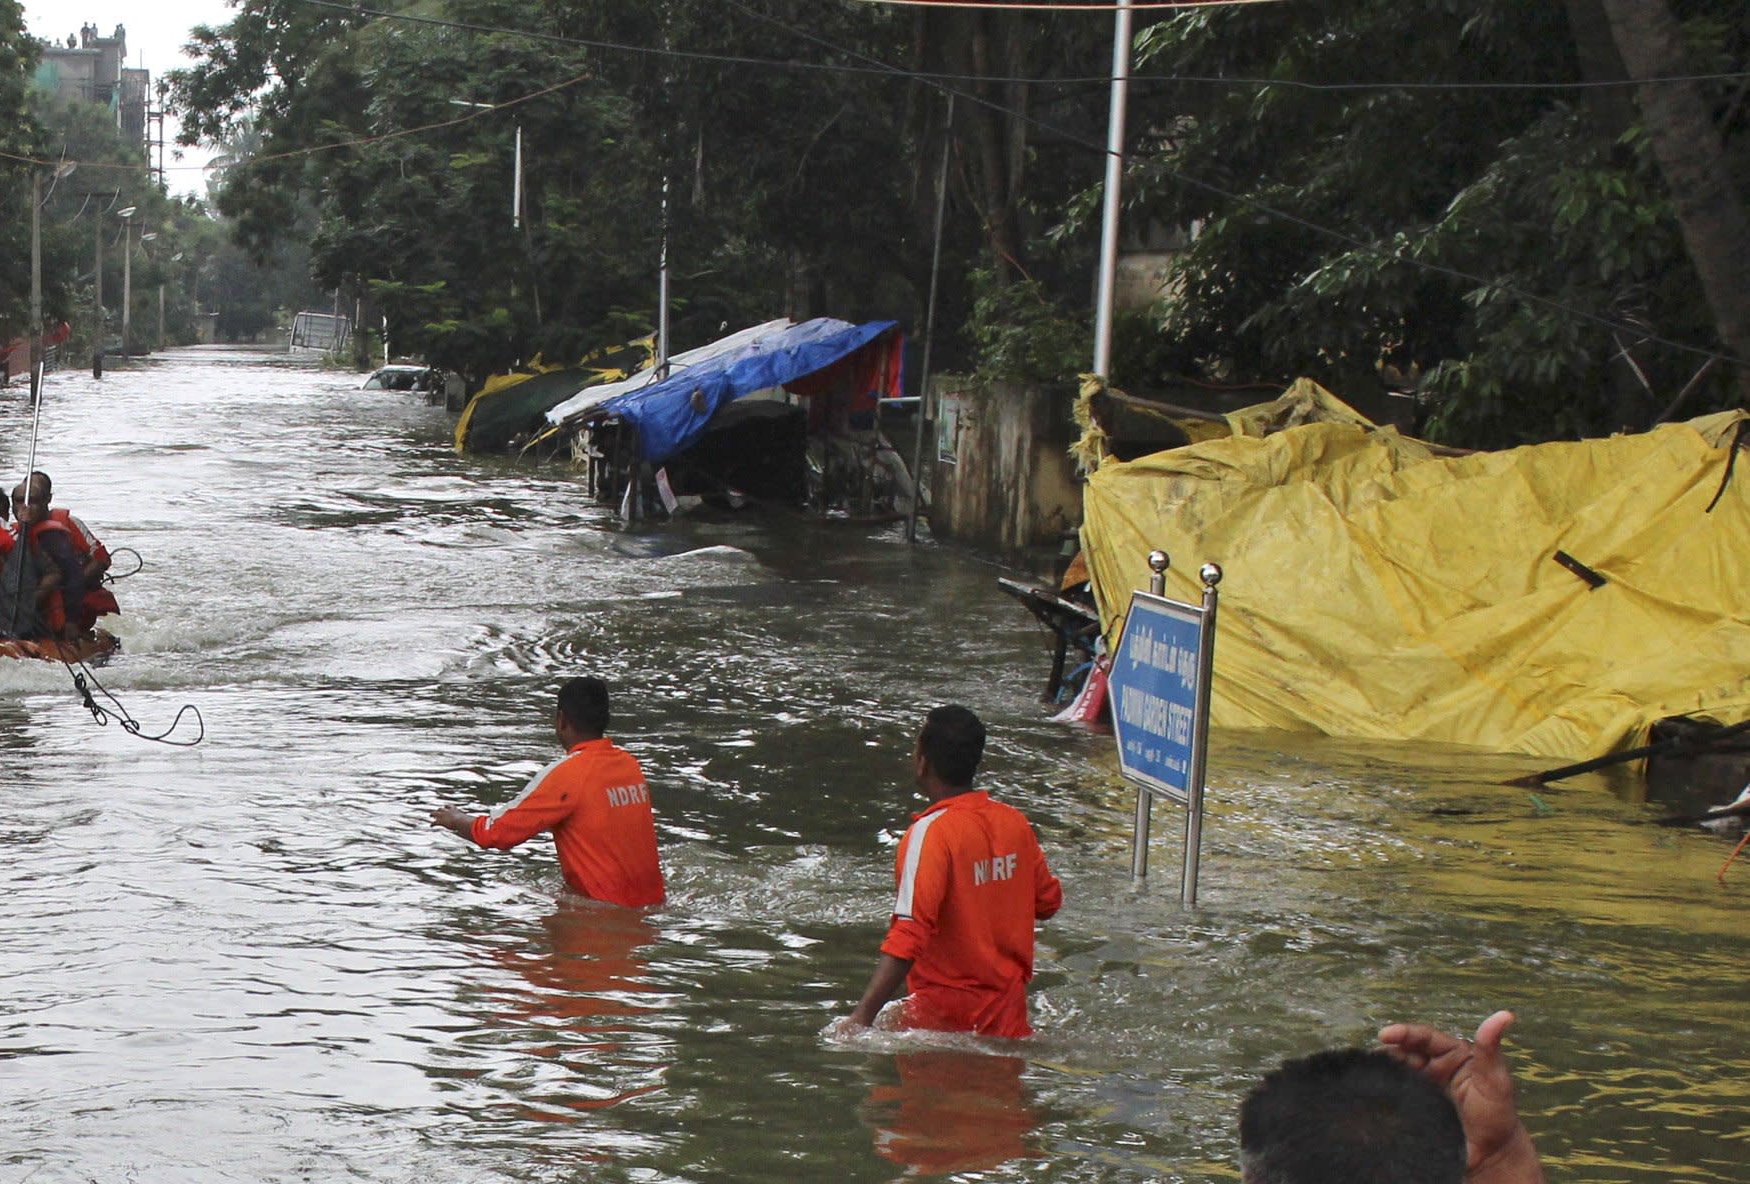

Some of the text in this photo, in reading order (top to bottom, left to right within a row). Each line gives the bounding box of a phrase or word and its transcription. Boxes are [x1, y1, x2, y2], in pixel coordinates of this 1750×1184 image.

[1167, 701, 1193, 747] STREET
[606, 783, 648, 808] NDRF
[973, 852, 1018, 887] NRF
